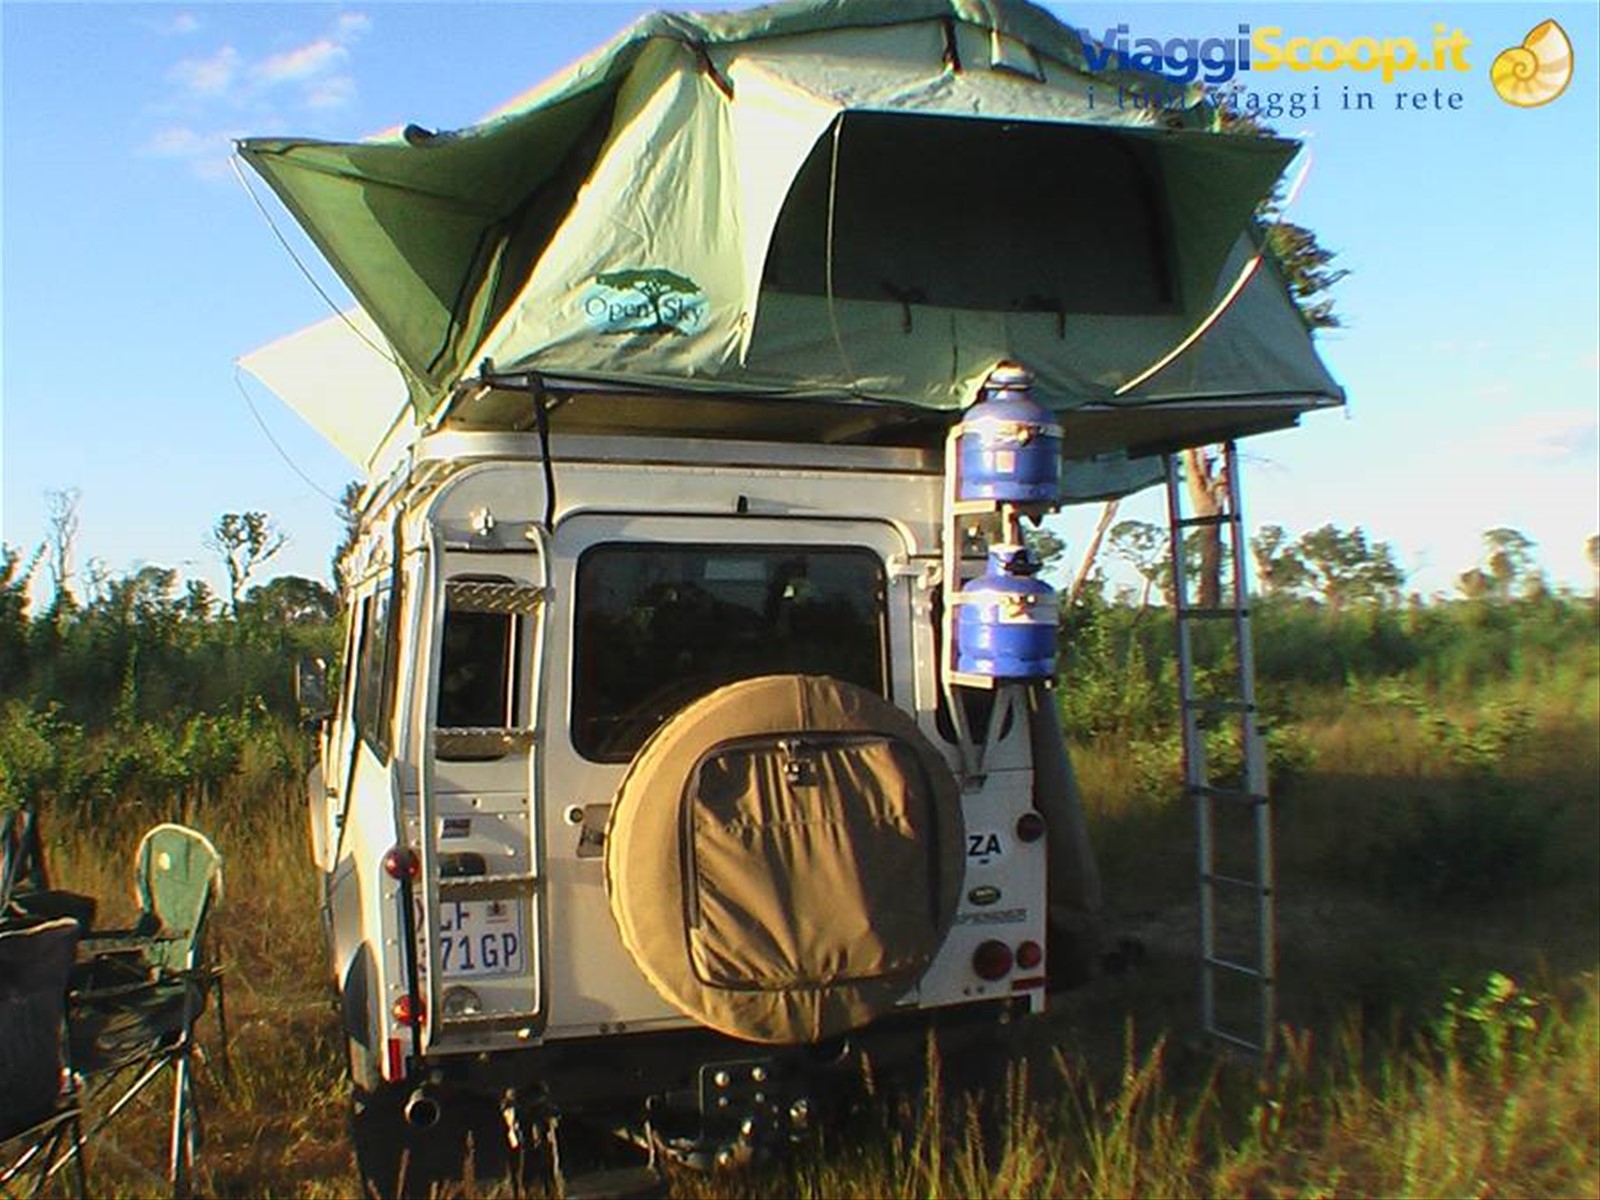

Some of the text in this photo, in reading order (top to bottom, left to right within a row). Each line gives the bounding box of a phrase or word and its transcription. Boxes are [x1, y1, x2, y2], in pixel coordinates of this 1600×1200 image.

[586, 297, 703, 325] Open Sky
[968, 834, 1001, 856] ZA
